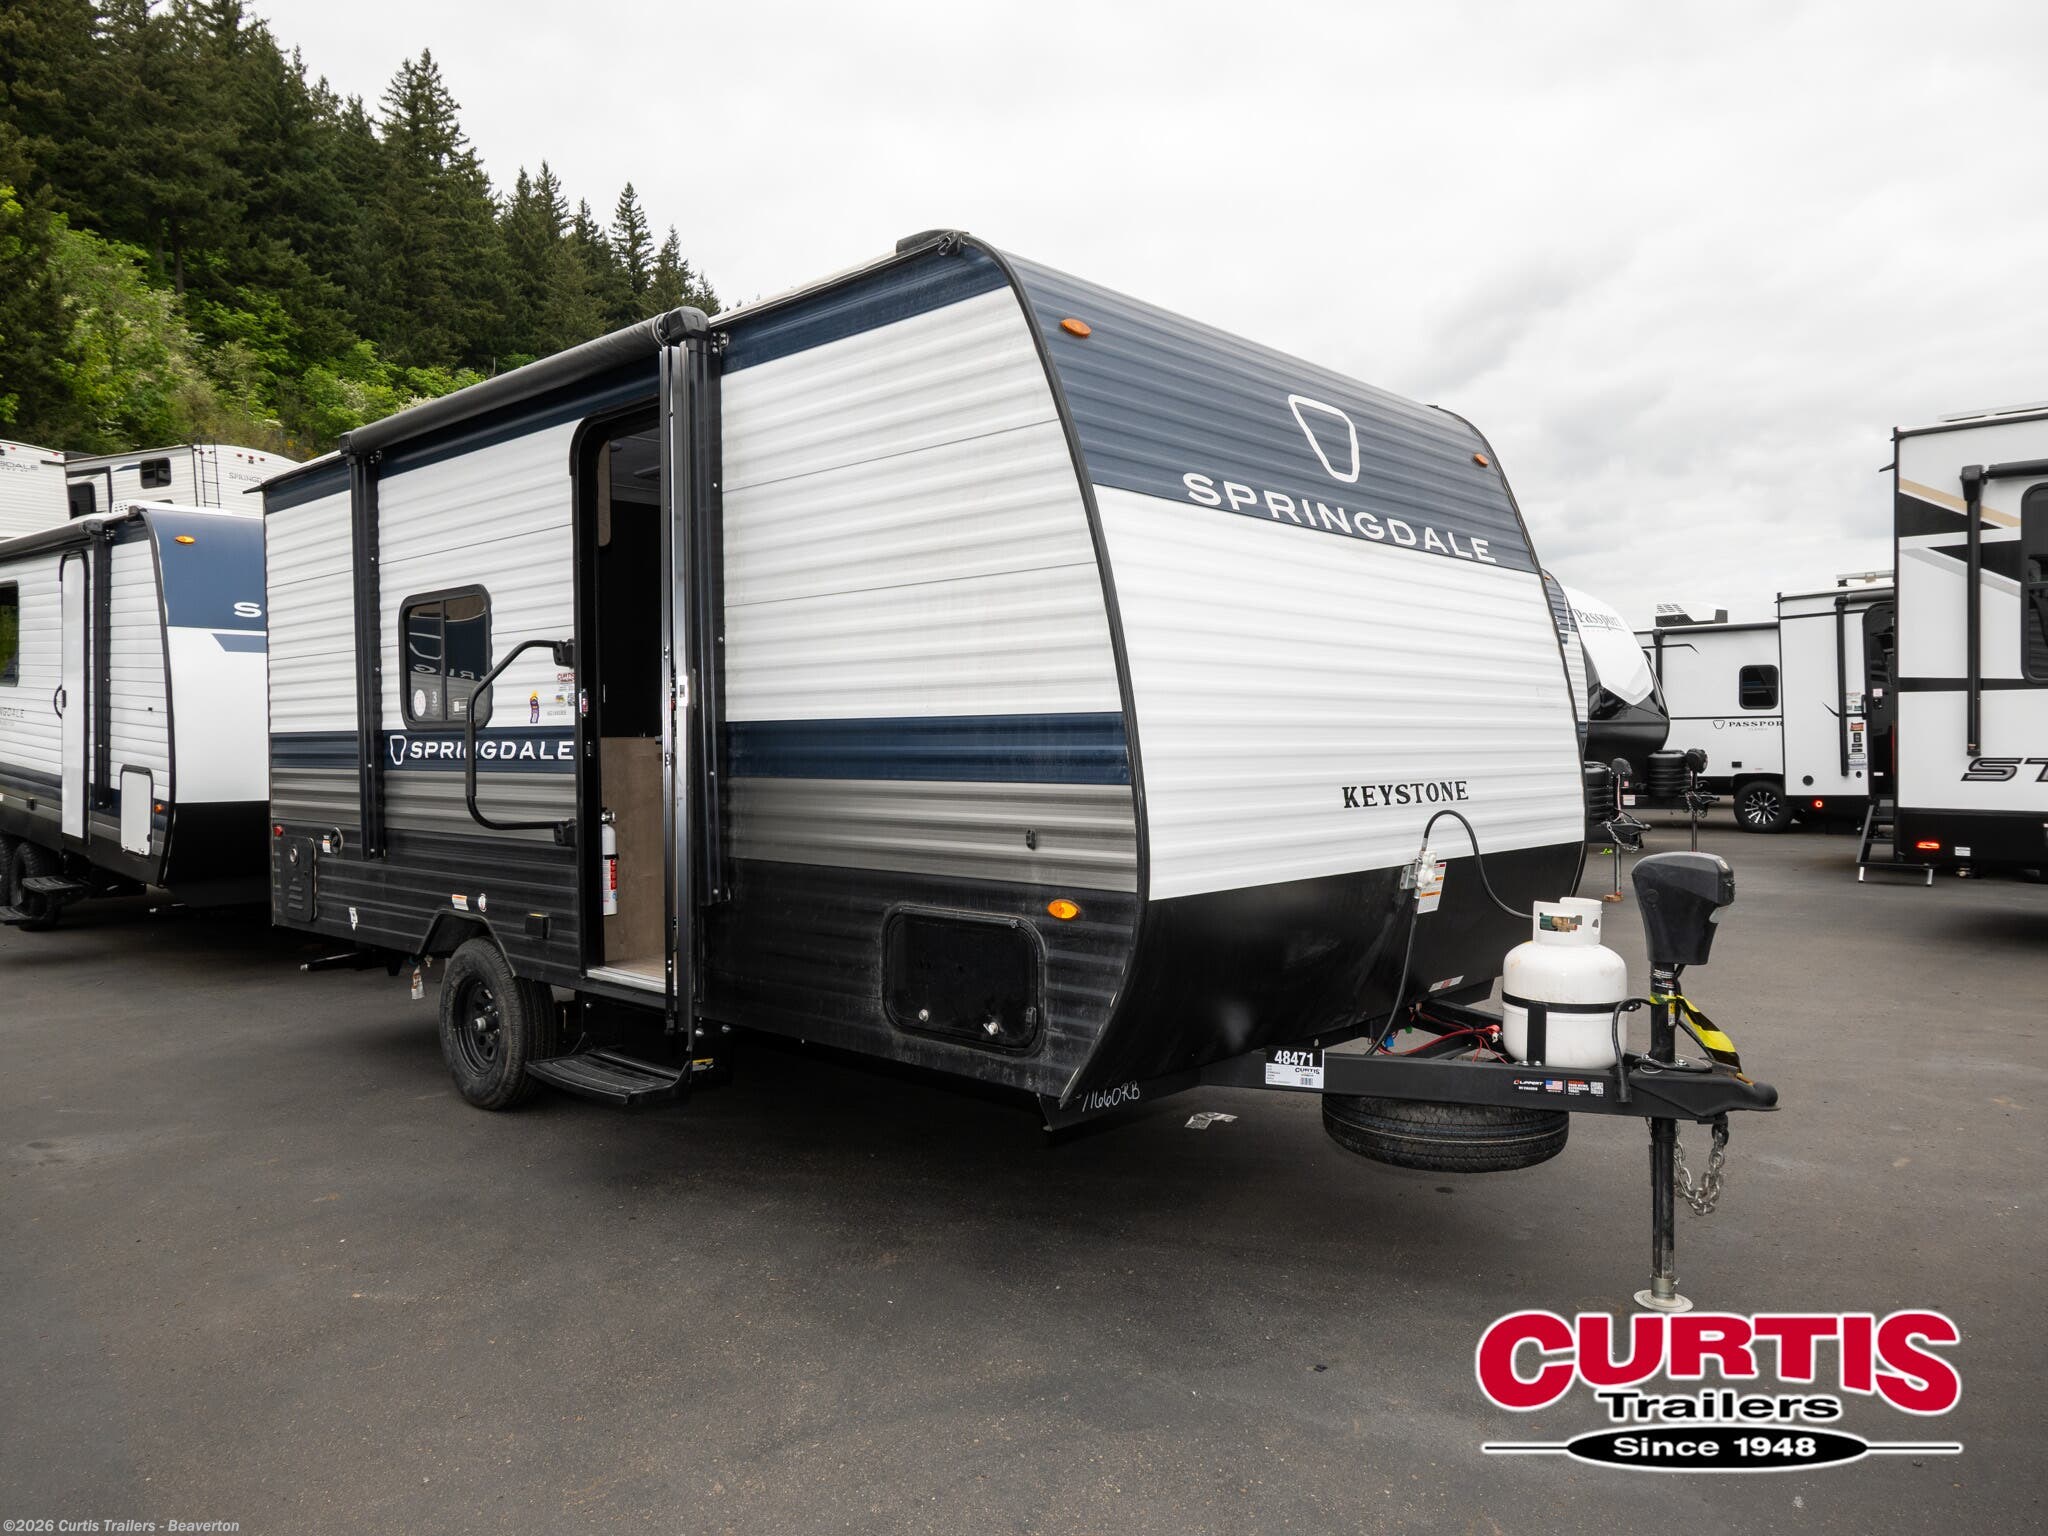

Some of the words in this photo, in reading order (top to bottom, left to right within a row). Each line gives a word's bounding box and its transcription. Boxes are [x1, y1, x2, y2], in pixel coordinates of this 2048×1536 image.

[1183, 472, 1496, 563] SPRINGDALE
[1341, 780, 1469, 809] KEYSTONE
[1274, 1050, 1314, 1067] 48471
